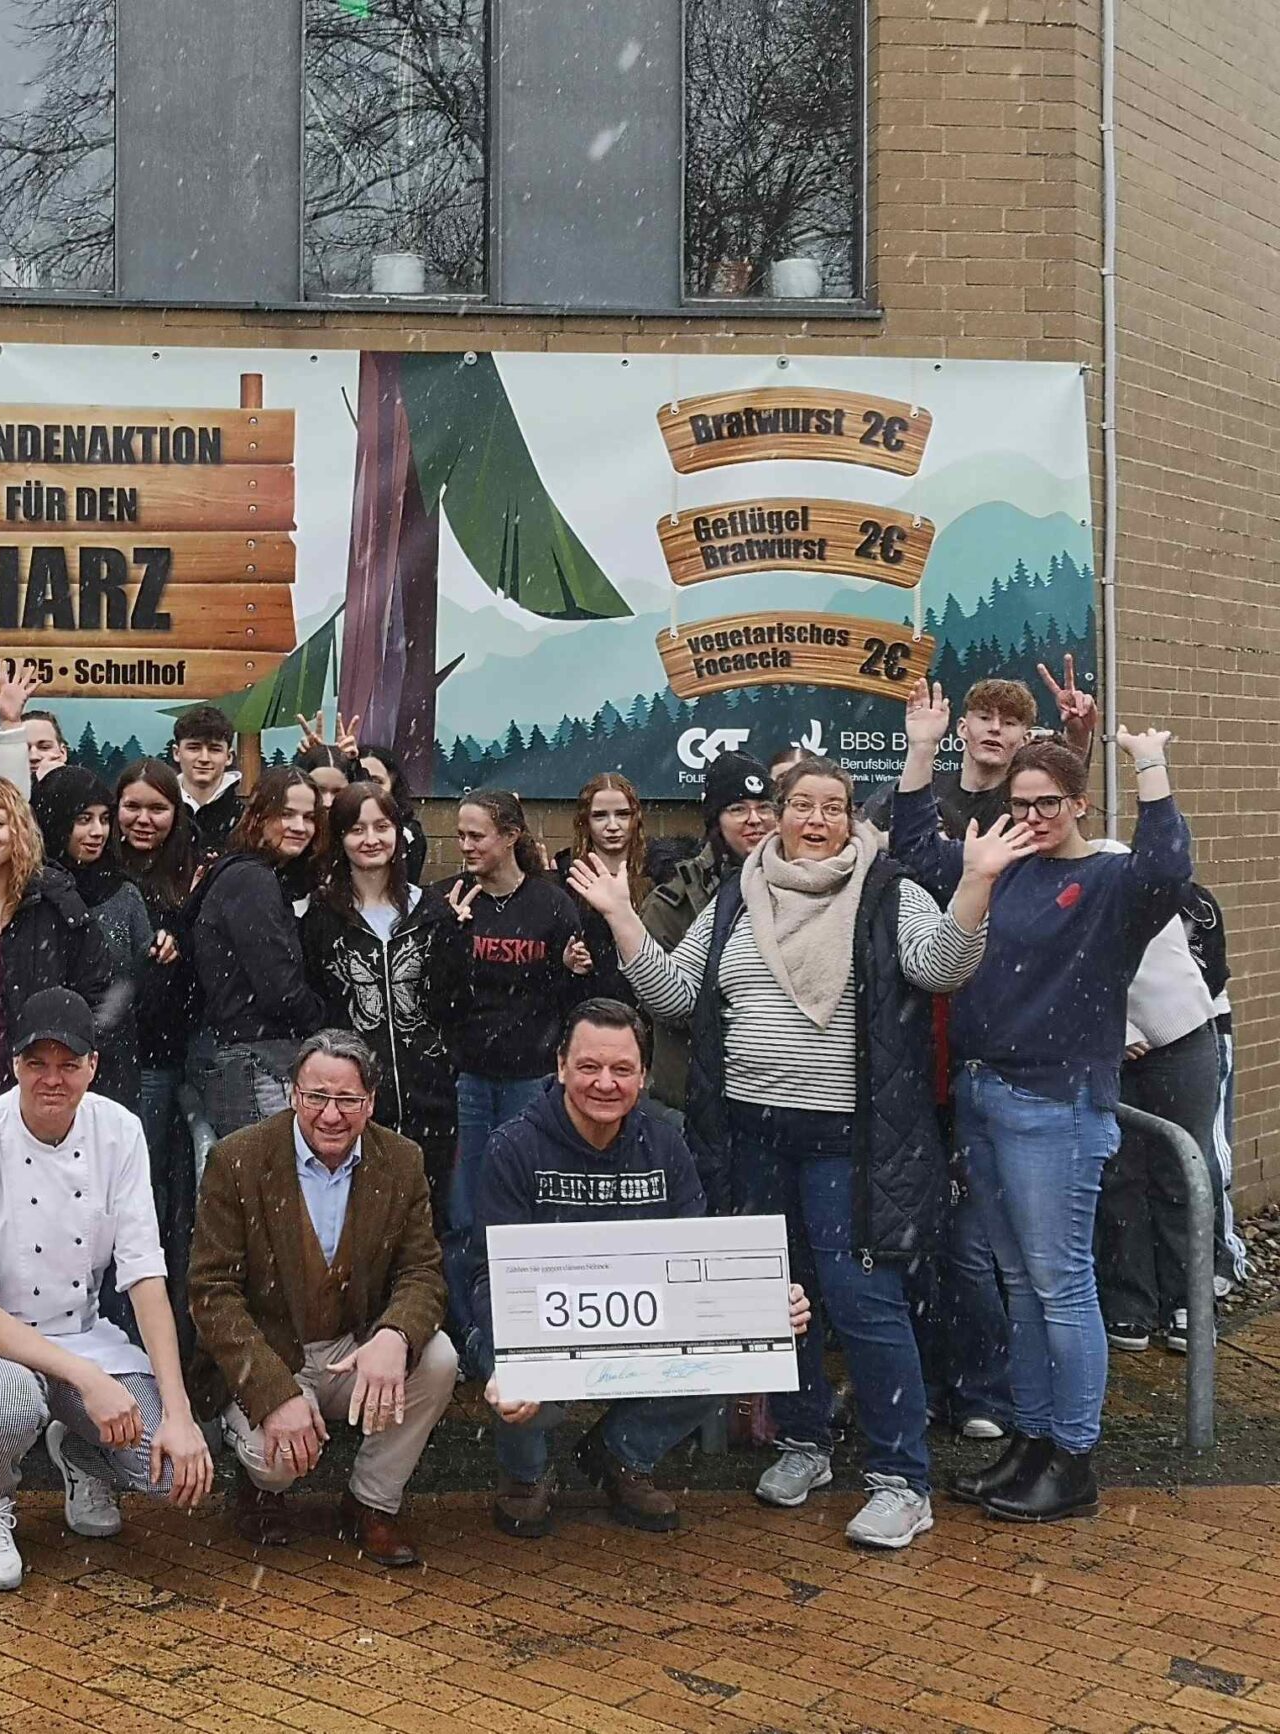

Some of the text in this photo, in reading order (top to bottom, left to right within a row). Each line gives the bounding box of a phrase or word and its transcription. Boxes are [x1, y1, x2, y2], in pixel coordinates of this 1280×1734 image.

[689, 407, 910, 452] Bratwurst 2€
[6, 479, 137, 522] FÜR DEN
[693, 506, 810, 543] Geflügel
[700, 520, 908, 570] Bratwurst 2€
[686, 622, 850, 654] vegetarisches
[74, 658, 187, 686] Schulhof
[692, 637, 911, 681] Focaccia 2€
[840, 731, 885, 751] BBS
[840, 757, 906, 770] Berufsbilde
[545, 1290, 658, 1329] 3500
